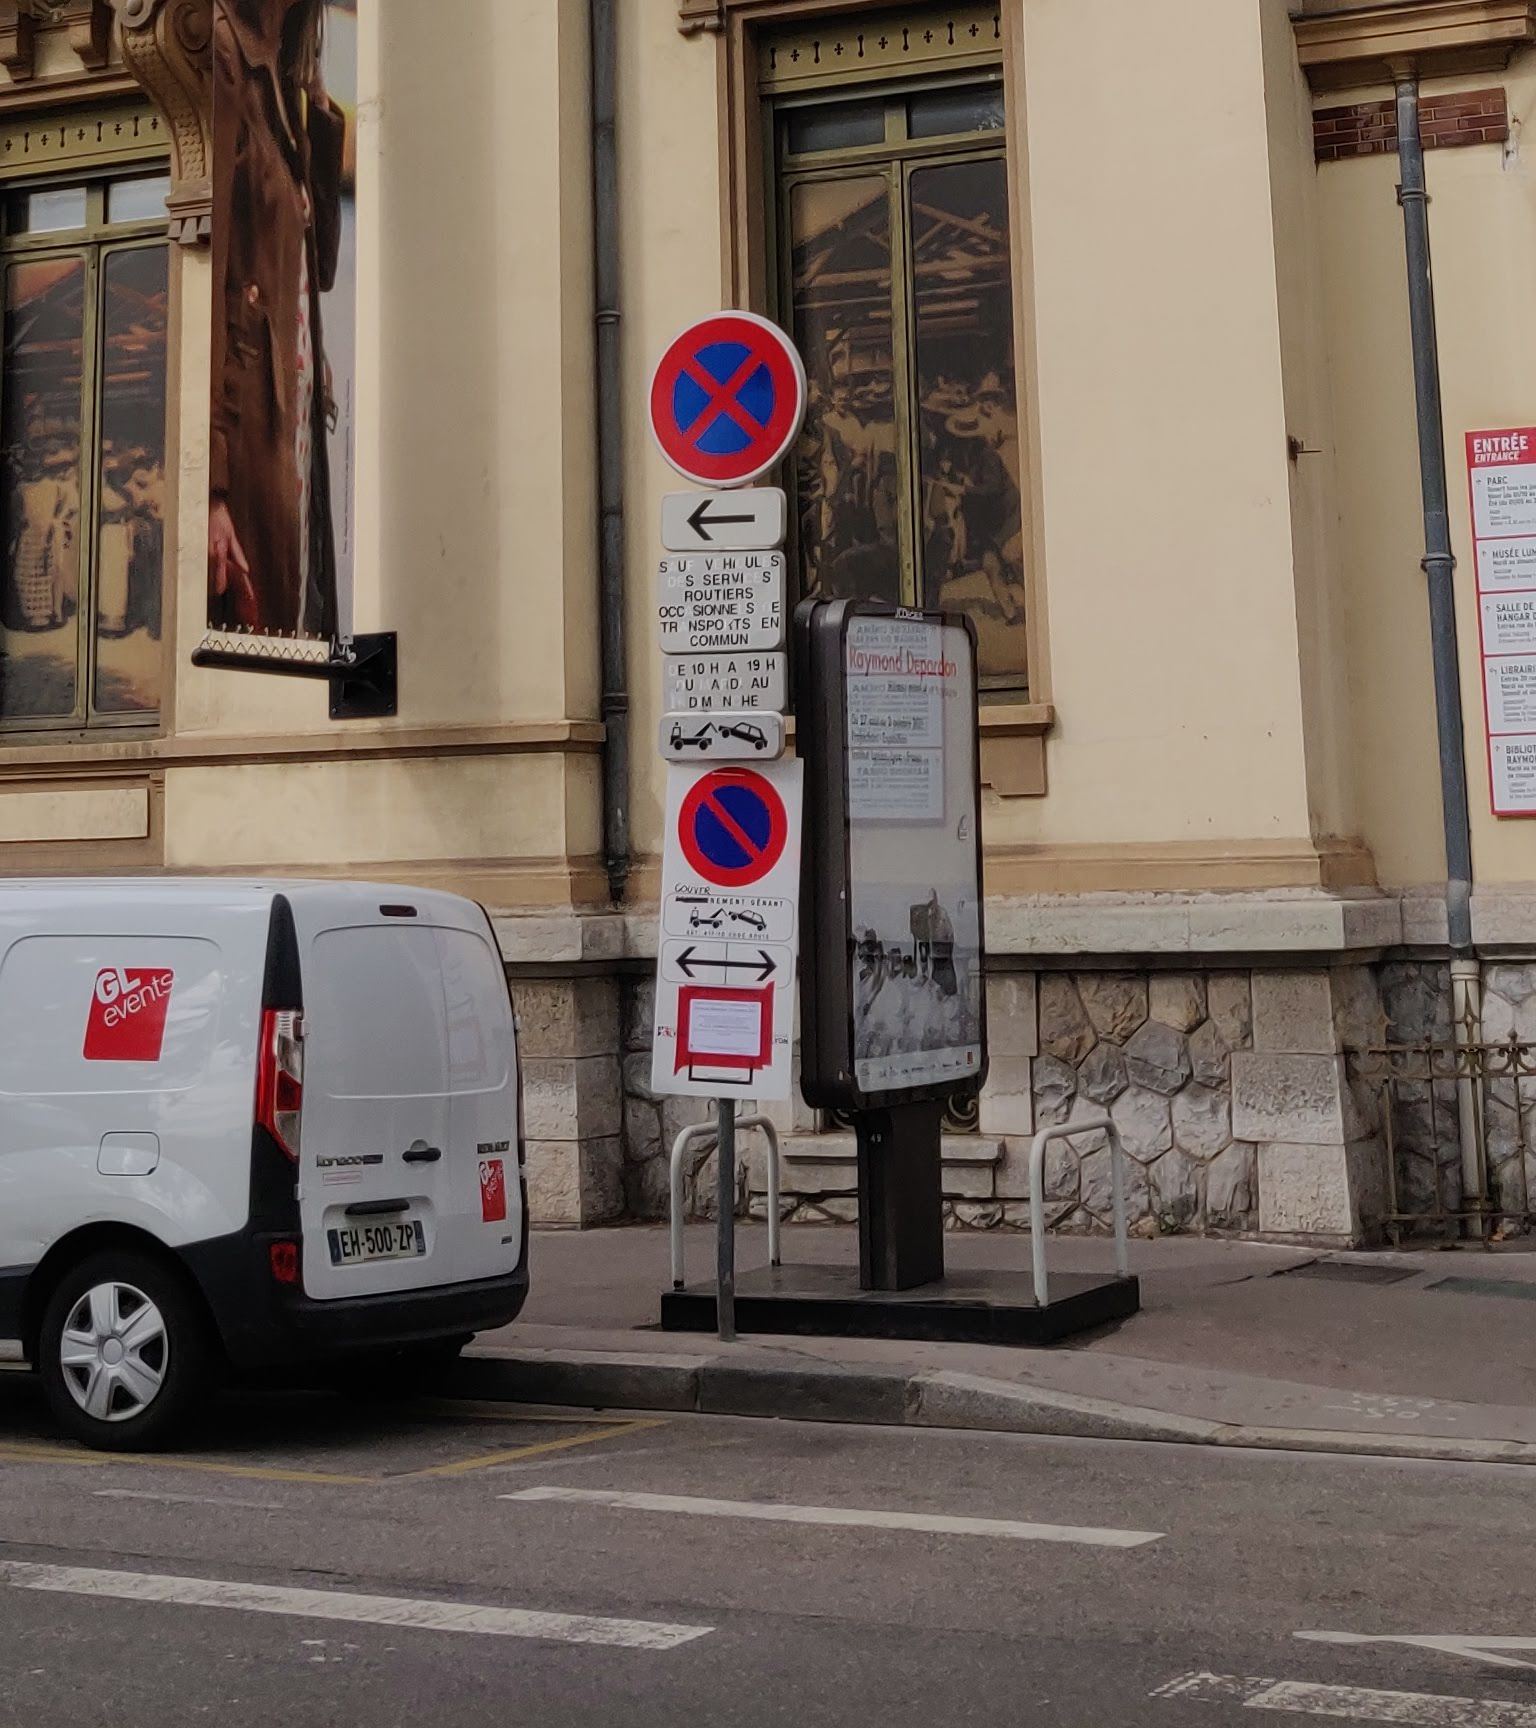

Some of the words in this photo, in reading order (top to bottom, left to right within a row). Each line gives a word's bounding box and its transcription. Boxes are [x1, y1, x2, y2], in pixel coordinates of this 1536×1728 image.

[1473, 433, 1528, 453] ENTRÉE
[1475, 451, 1520, 463] ENTRANCE
[1487, 476, 1508, 485] PARC
[1493, 548, 1519, 558] MUSÉE
[658, 559, 694, 574] SUF
[705, 554, 780, 571] VHIULS
[684, 587, 754, 603] ROUTIERS
[658, 602, 755, 618] OCCSIONNES
[1496, 602, 1520, 612] SALLE
[1524, 602, 1533, 610] DE
[1497, 611, 1530, 622] HANGAR
[660, 617, 751, 633] TRNSPORTS
[761, 616, 780, 630] EN
[690, 633, 749, 647] COMMUN
[692, 662, 705, 675] 10
[710, 661, 719, 674] H
[727, 660, 737, 673] A
[747, 658, 760, 672] 19
[766, 657, 776, 671] H
[750, 675, 770, 689] AU
[688, 694, 760, 709] DIMNHE
[751, 896, 783, 907] GÊNANT
[96, 967, 141, 1004] GL
[104, 973, 173, 1027] events
[340, 1224, 413, 1258] EH-500-ZP
